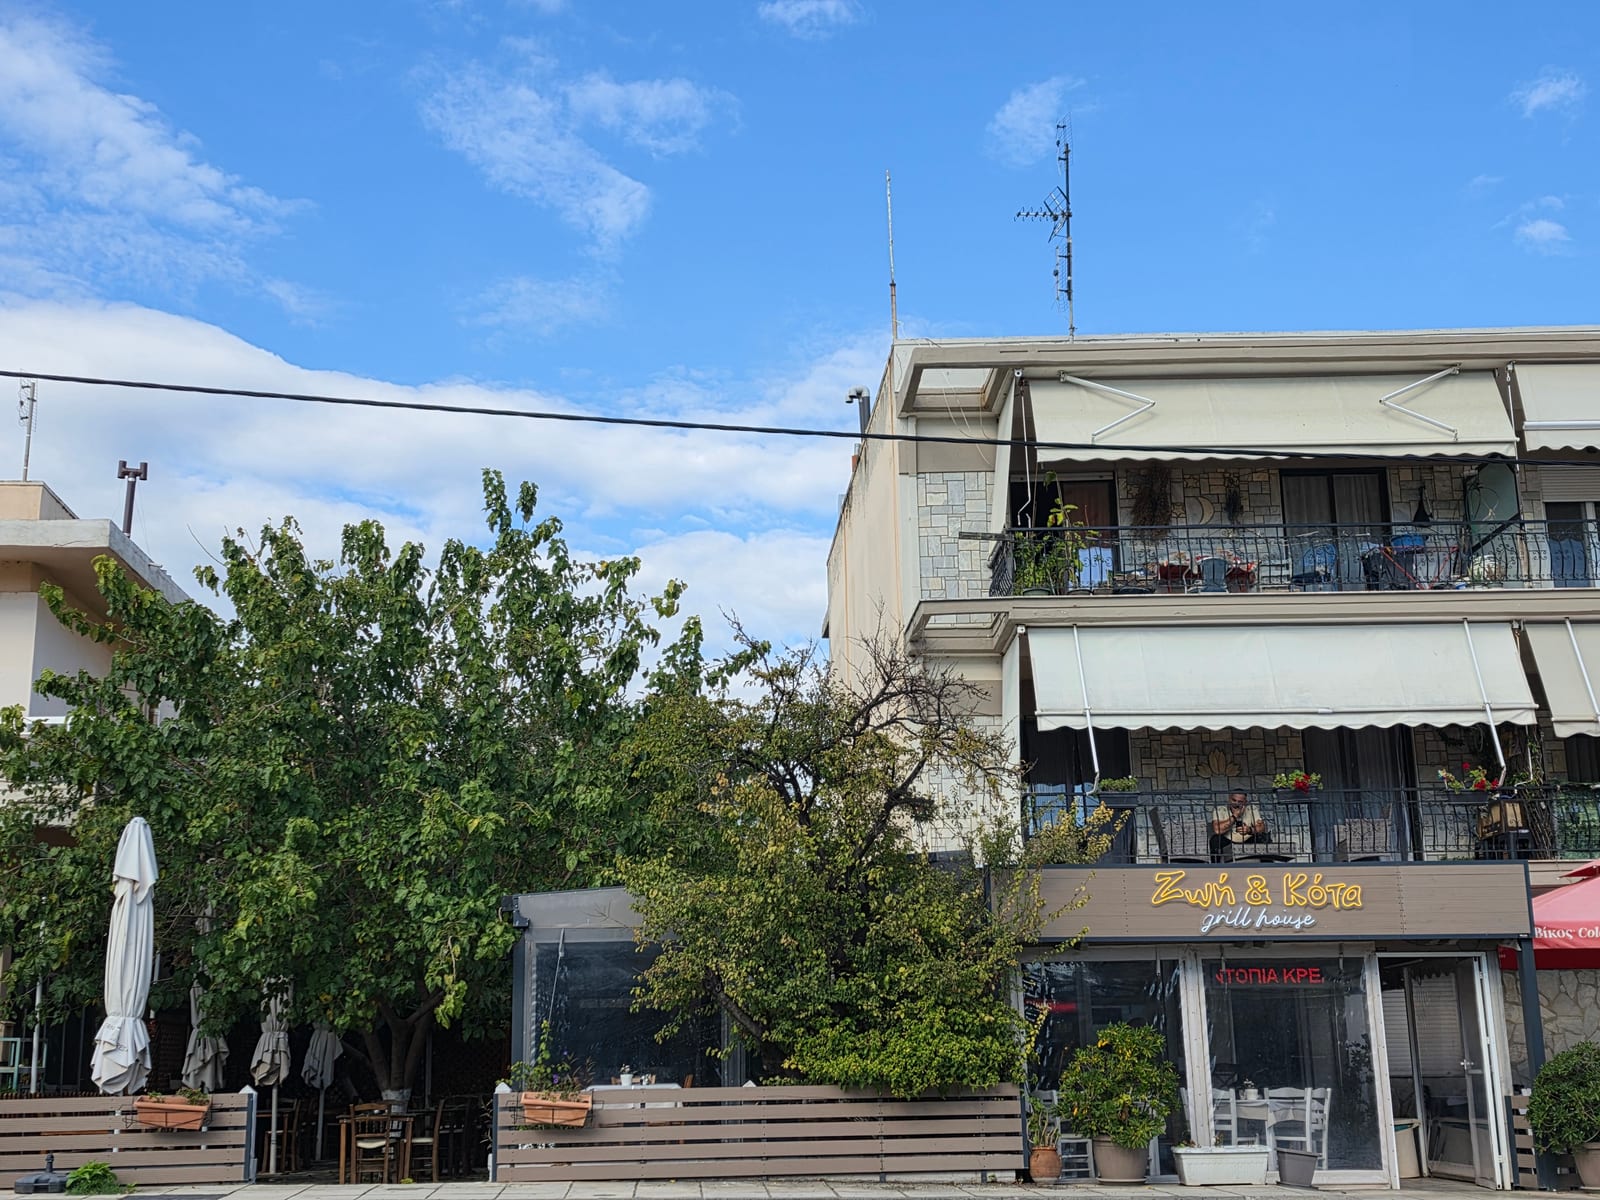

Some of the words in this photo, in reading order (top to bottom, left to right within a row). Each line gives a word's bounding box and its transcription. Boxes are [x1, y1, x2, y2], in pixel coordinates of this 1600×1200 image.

[1151, 870, 1235, 906] Ζωή
[1245, 874, 1271, 905] &
[1283, 872, 1362, 908] Κότα
[1201, 907, 1251, 932] grill
[1255, 908, 1316, 928] house
[1534, 927, 1573, 939] Βίκος
[1578, 926, 1600, 938] Col
[1283, 967, 1325, 984] ΚΡΕ
